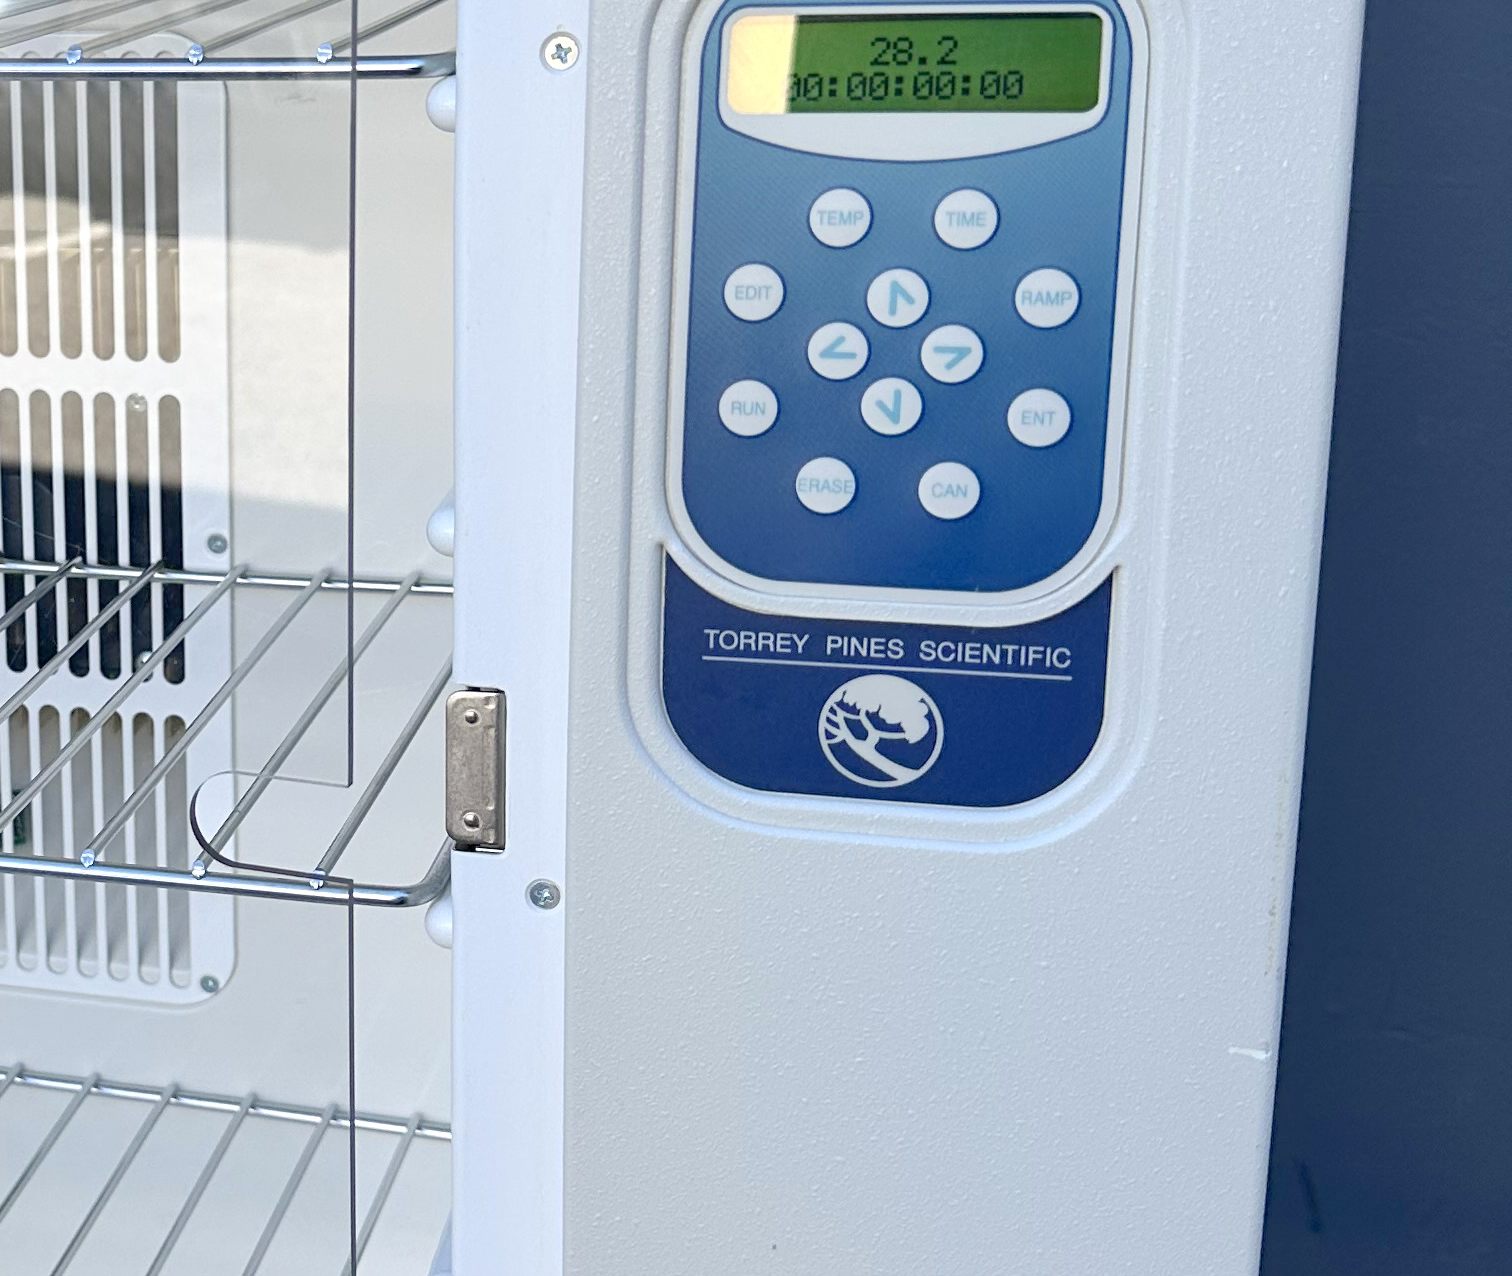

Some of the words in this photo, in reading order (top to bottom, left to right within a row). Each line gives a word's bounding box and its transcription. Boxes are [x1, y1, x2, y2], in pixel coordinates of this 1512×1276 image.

[870, 36, 959, 66] 28.2
[817, 210, 864, 227] TEMP
[946, 211, 988, 228] TIME
[734, 284, 772, 301] EDIT
[1021, 289, 1073, 306] RAMP
[731, 400, 766, 417] RUN
[1021, 409, 1056, 427] ENT
[798, 477, 854, 495] ERASE
[931, 482, 968, 499] CAN
[704, 628, 810, 654] TORREY
[825, 635, 905, 660] PINES
[919, 640, 1072, 669] SCIENTIFIC
